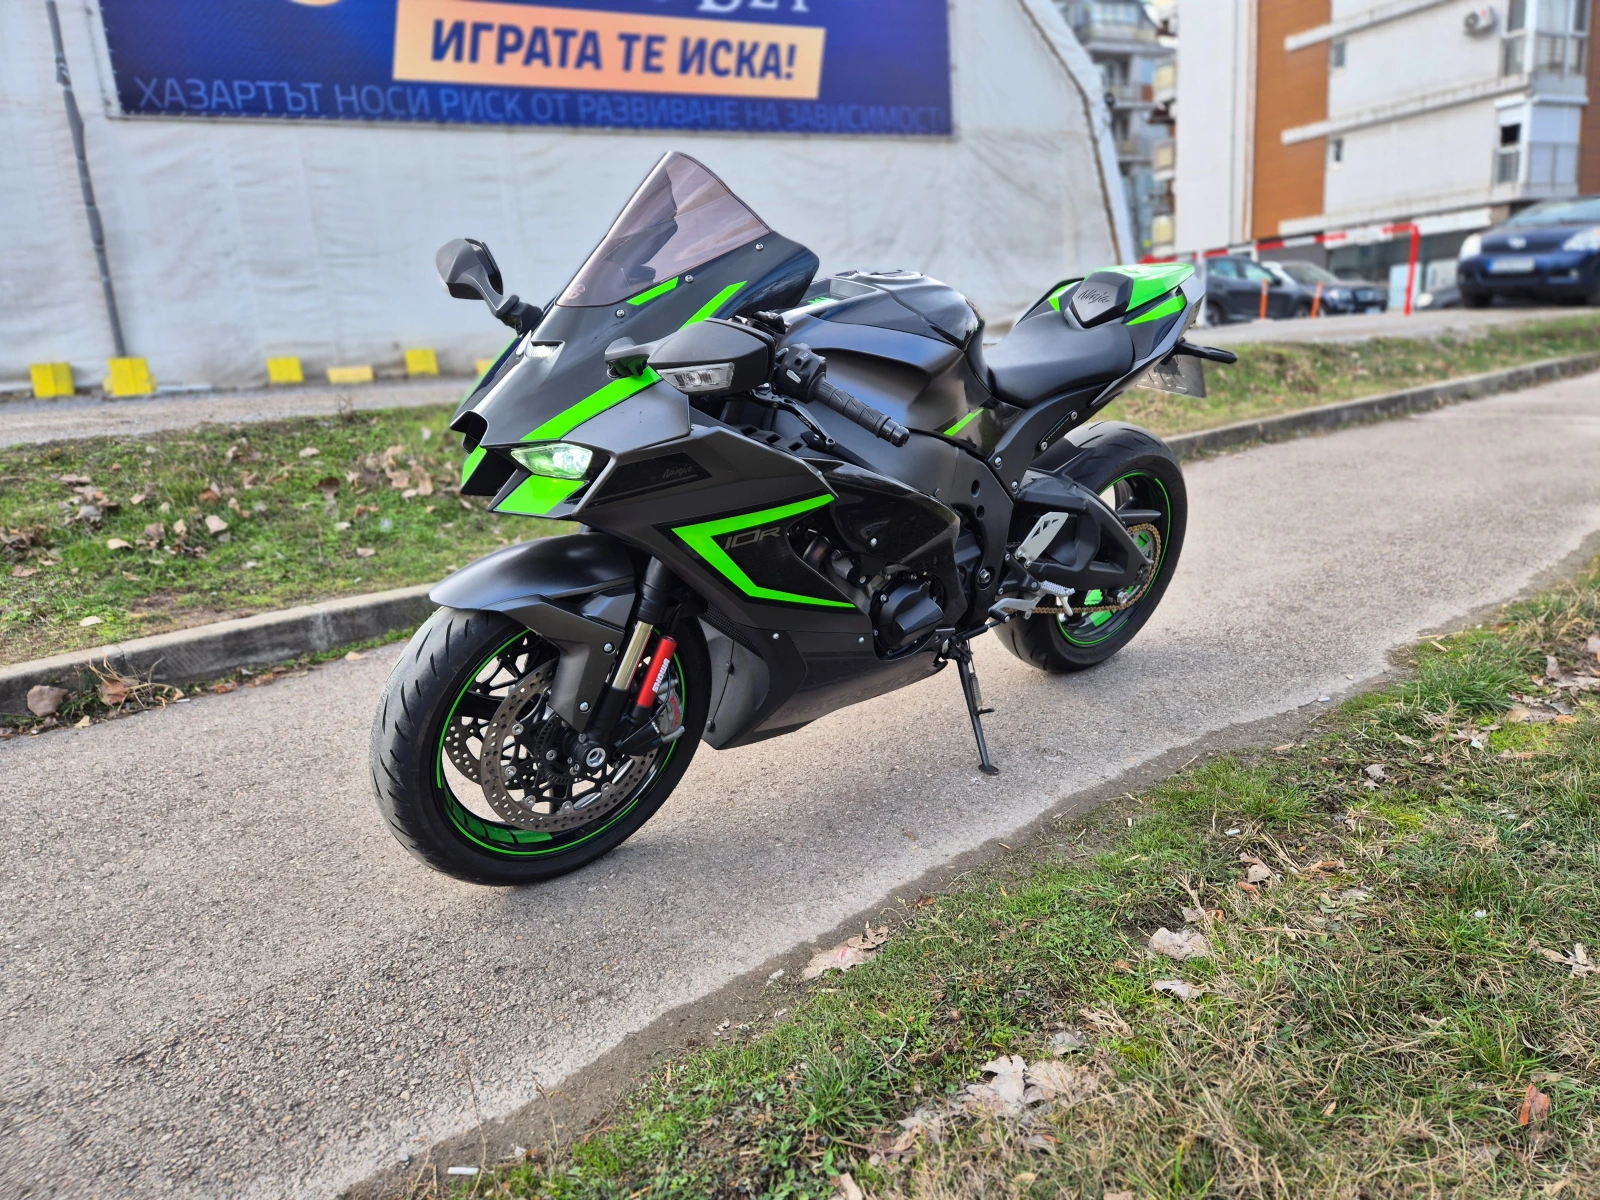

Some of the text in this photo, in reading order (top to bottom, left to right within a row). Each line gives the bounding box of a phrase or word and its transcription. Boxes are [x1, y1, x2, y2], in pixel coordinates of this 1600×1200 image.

[432, 19, 797, 80] ИГРАТА ТЕ ИСКА!
[134, 76, 322, 113] ХАЗАРТЪТ
[334, 84, 431, 117] НОСИ
[440, 88, 525, 120] РИСК
[531, 93, 570, 122] ОТ
[577, 94, 738, 127] РАЗВИВАНЕ
[744, 100, 781, 129] НА
[1078, 288, 1110, 304] Ninja
[662, 464, 694, 478] Ninja
[724, 526, 781, 550] 10R
[652, 657, 670, 693] SHOWA
